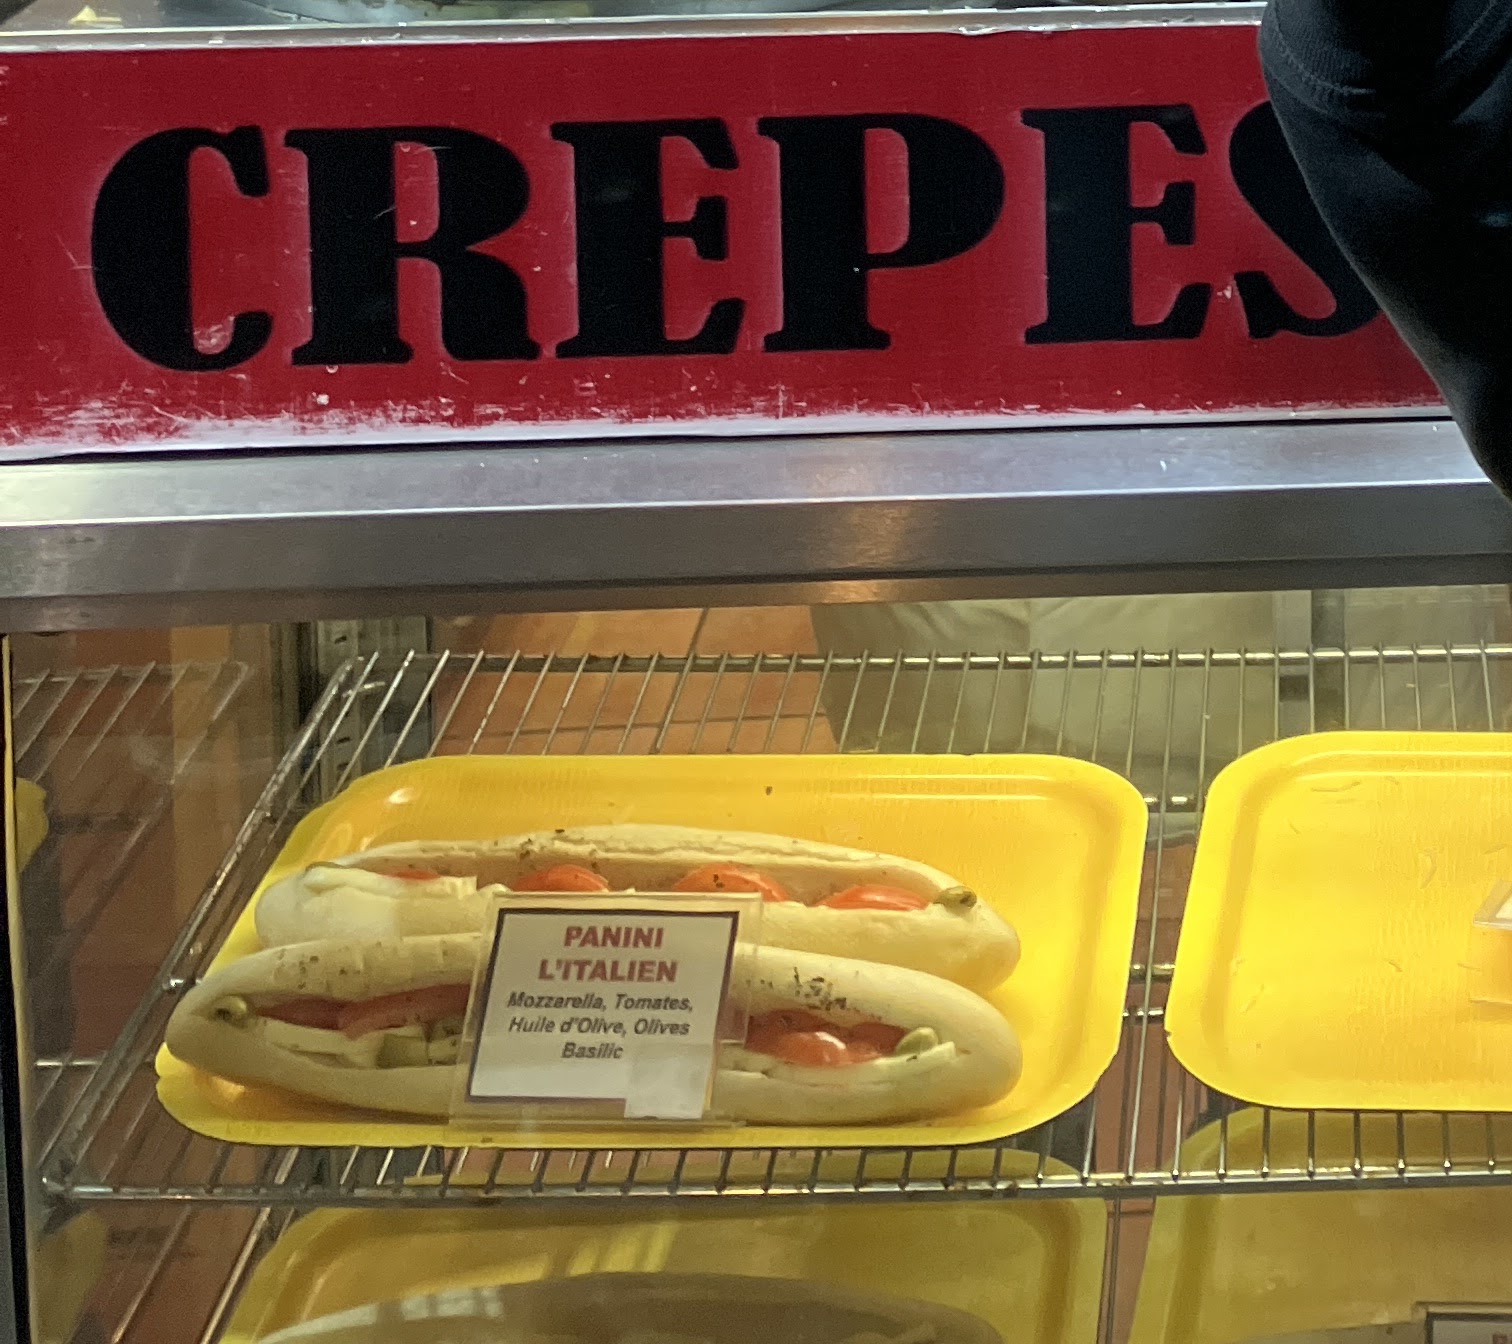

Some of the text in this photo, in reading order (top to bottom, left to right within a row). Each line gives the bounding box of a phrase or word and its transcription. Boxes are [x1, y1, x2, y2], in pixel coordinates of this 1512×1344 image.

[564, 925, 664, 950] PANINI
[538, 959, 678, 983] L'ITALIEN
[507, 991, 693, 1012] Mozzarella, Tomates,
[508, 1016, 555, 1033] Huile
[633, 1018, 690, 1035] Olives
[561, 1042, 623, 1059] Basilic
